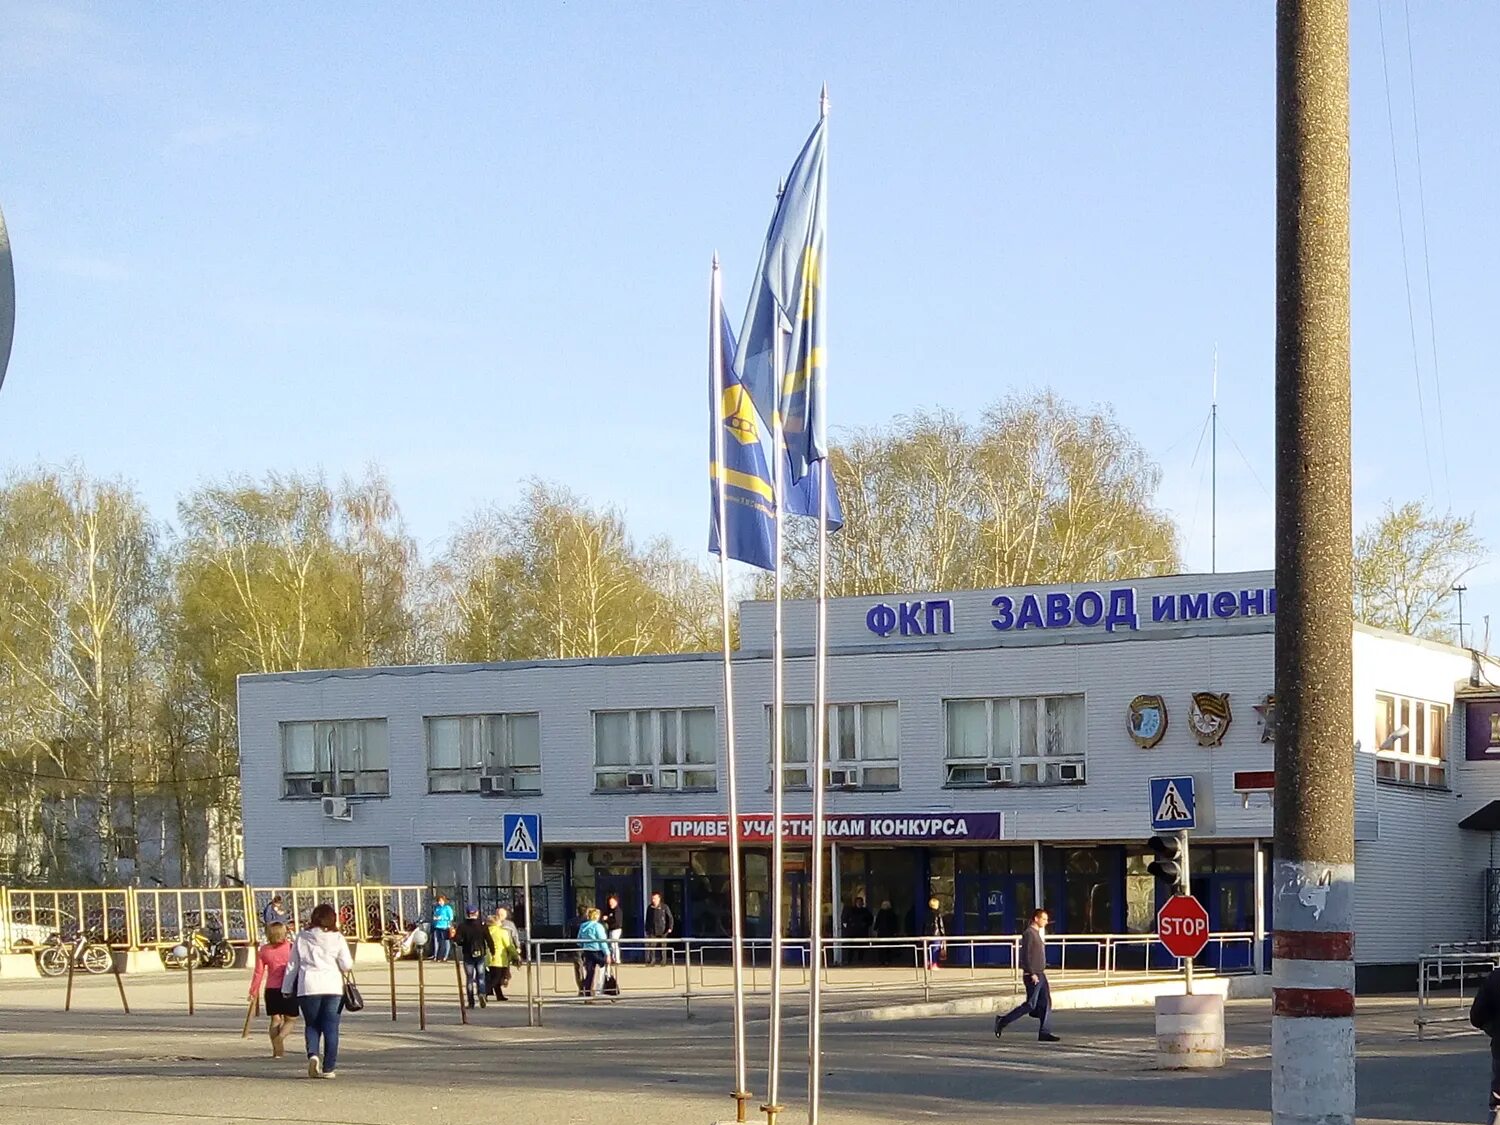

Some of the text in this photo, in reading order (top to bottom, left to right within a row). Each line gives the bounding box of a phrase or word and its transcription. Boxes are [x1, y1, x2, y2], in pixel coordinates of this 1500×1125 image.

[866, 588, 1276, 637] ФКП ЗАВОД имен
[670, 820, 737, 836] ПРИВЕ
[870, 818, 968, 835] КОНКУРСА
[1161, 917, 1206, 936] STOP
